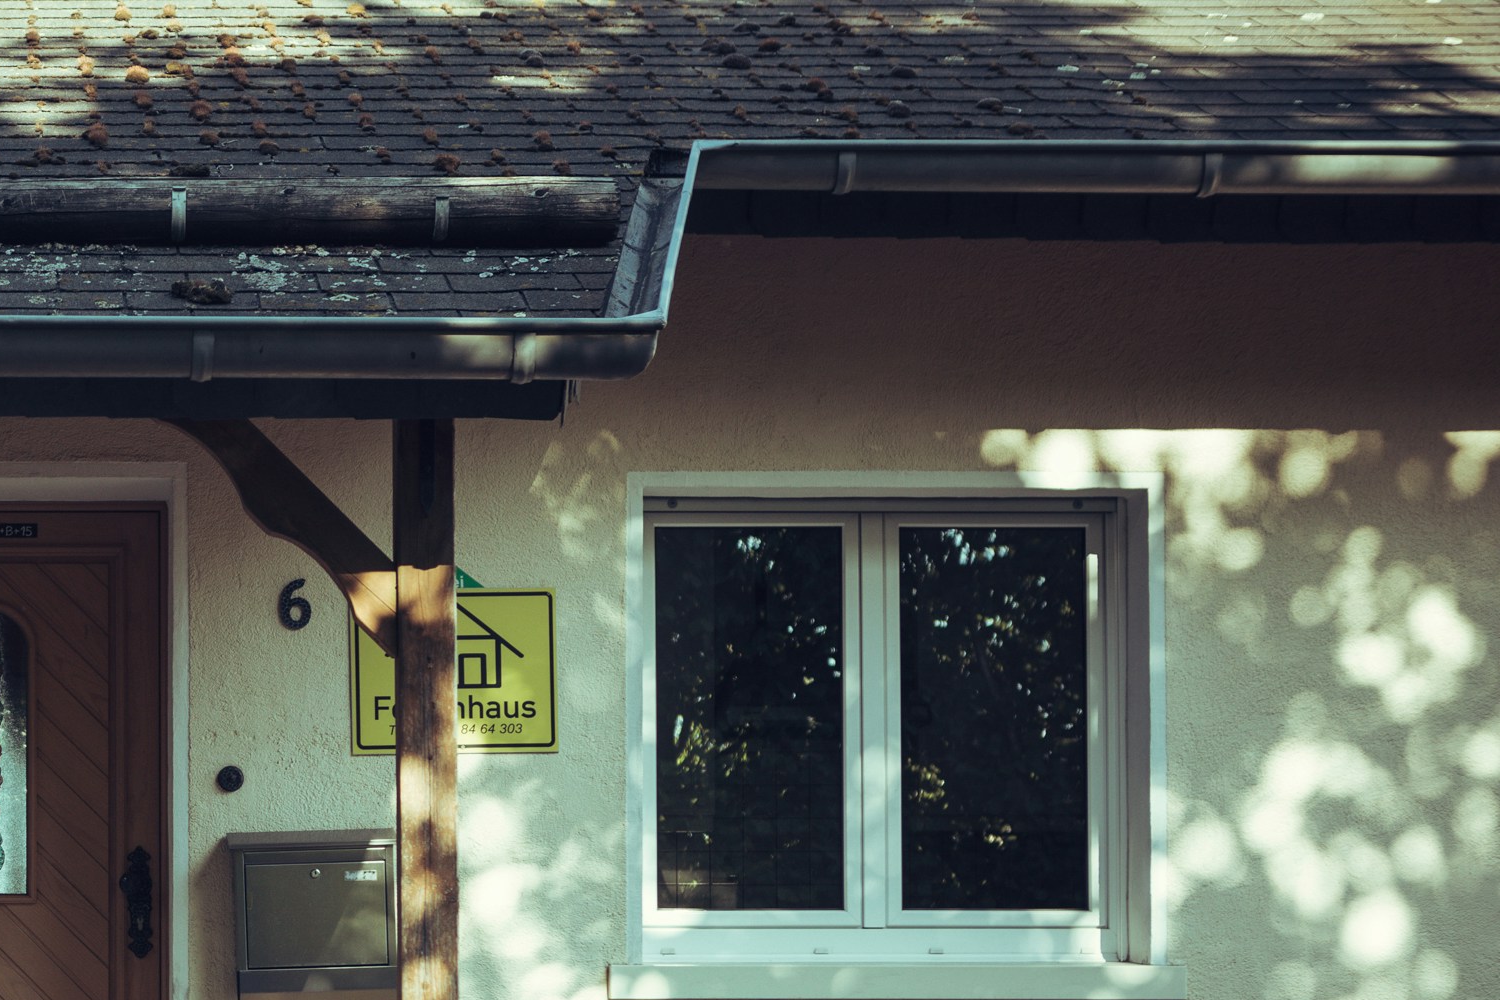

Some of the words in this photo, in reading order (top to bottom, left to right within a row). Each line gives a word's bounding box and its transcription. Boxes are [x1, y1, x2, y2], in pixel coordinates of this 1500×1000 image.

[278, 578, 312, 631] 6
[461, 723, 477, 735] 84
[480, 723, 496, 735] 64
[499, 723, 523, 734] 303
